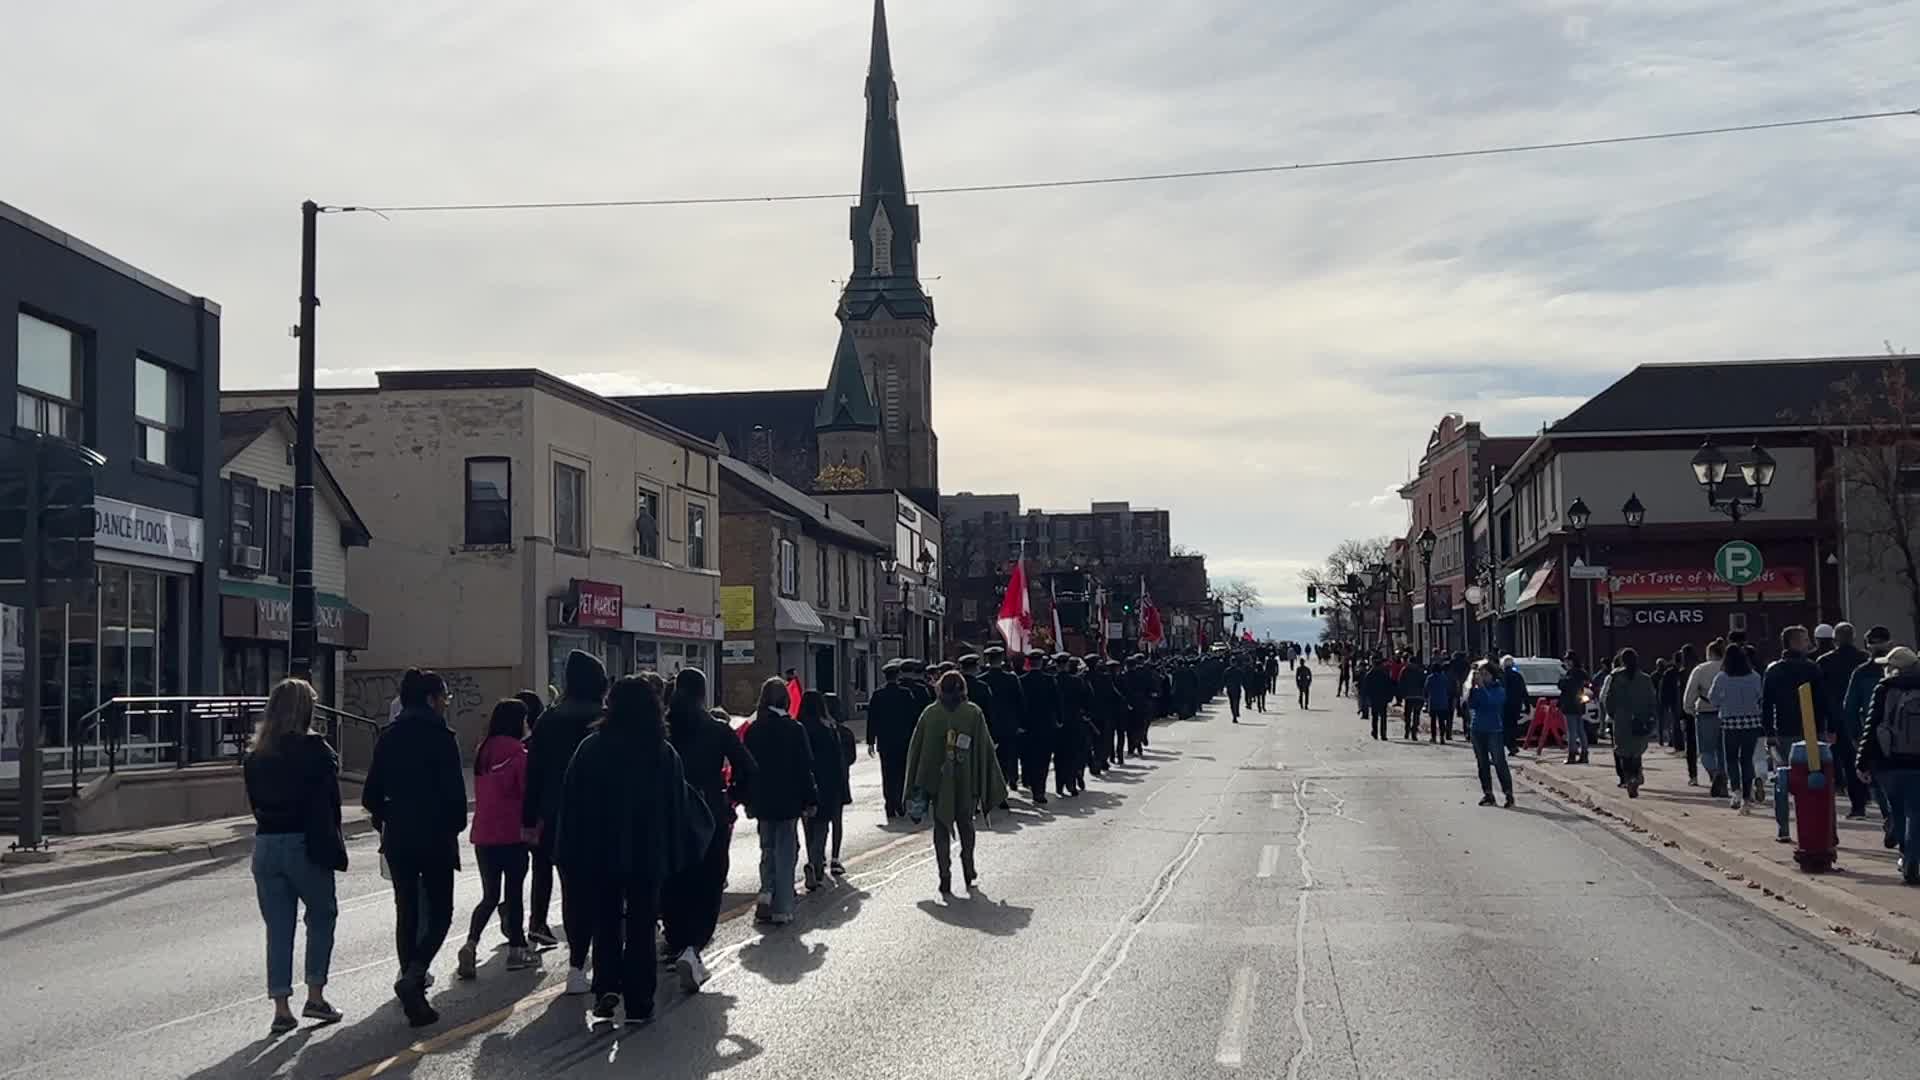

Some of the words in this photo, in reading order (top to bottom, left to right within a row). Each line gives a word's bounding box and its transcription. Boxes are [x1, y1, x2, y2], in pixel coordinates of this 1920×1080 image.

[95, 511, 132, 538] DANCE
[1725, 547, 1752, 580] P
[1648, 571, 1683, 585] Taste
[1688, 571, 1703, 584] of
[578, 592, 593, 614] PET
[593, 594, 621, 617] MARKET
[1635, 609, 1704, 624] CIGARS
